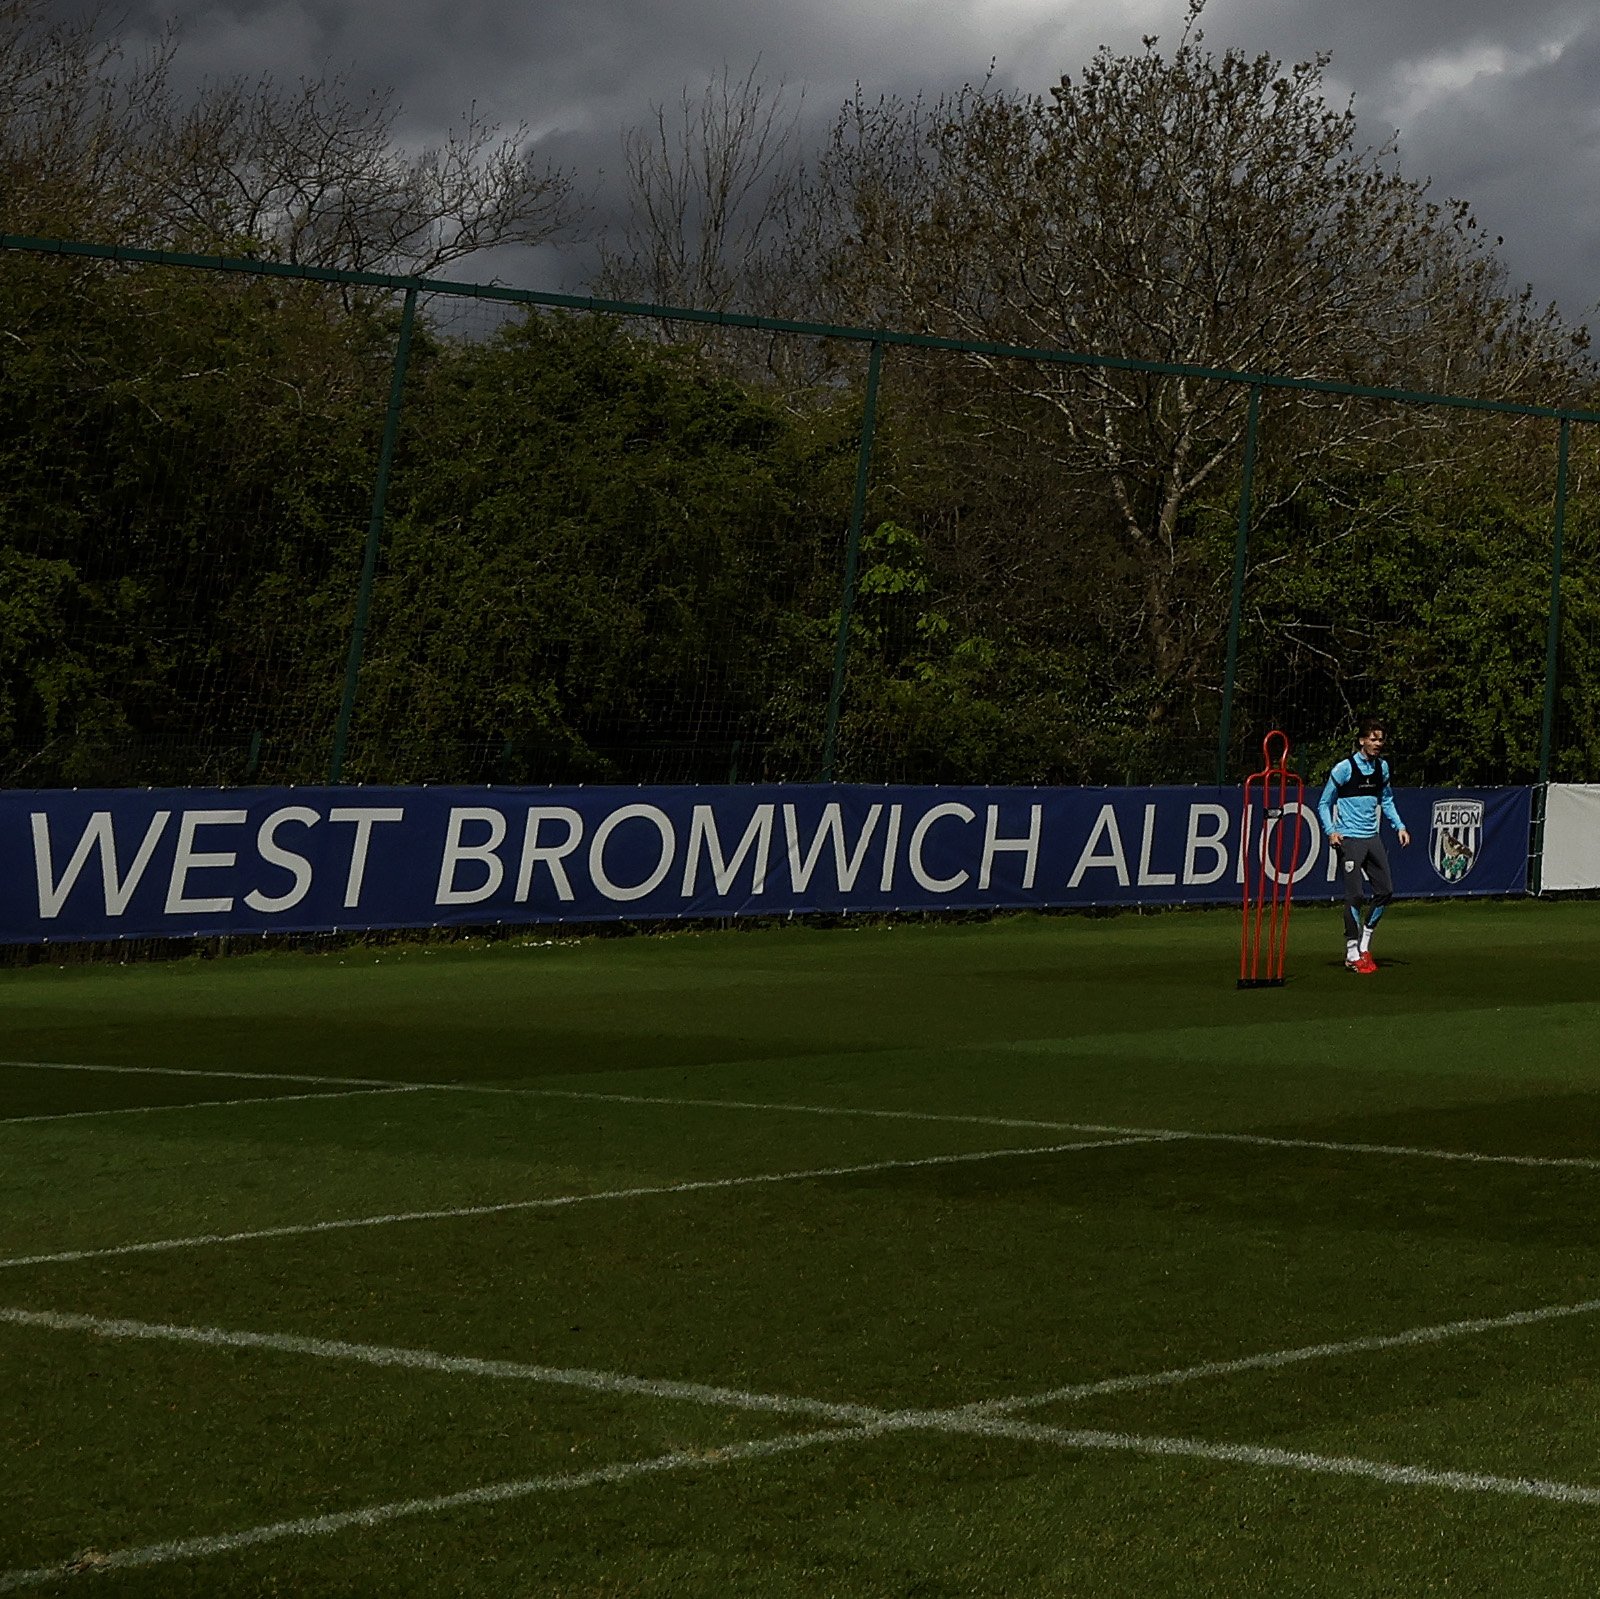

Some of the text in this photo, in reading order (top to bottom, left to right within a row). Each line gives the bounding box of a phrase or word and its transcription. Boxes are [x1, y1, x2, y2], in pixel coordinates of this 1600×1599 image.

[1434, 811, 1480, 825] ALBION
[29, 805, 405, 919] WEST
[434, 801, 1043, 905] BROMWICH
